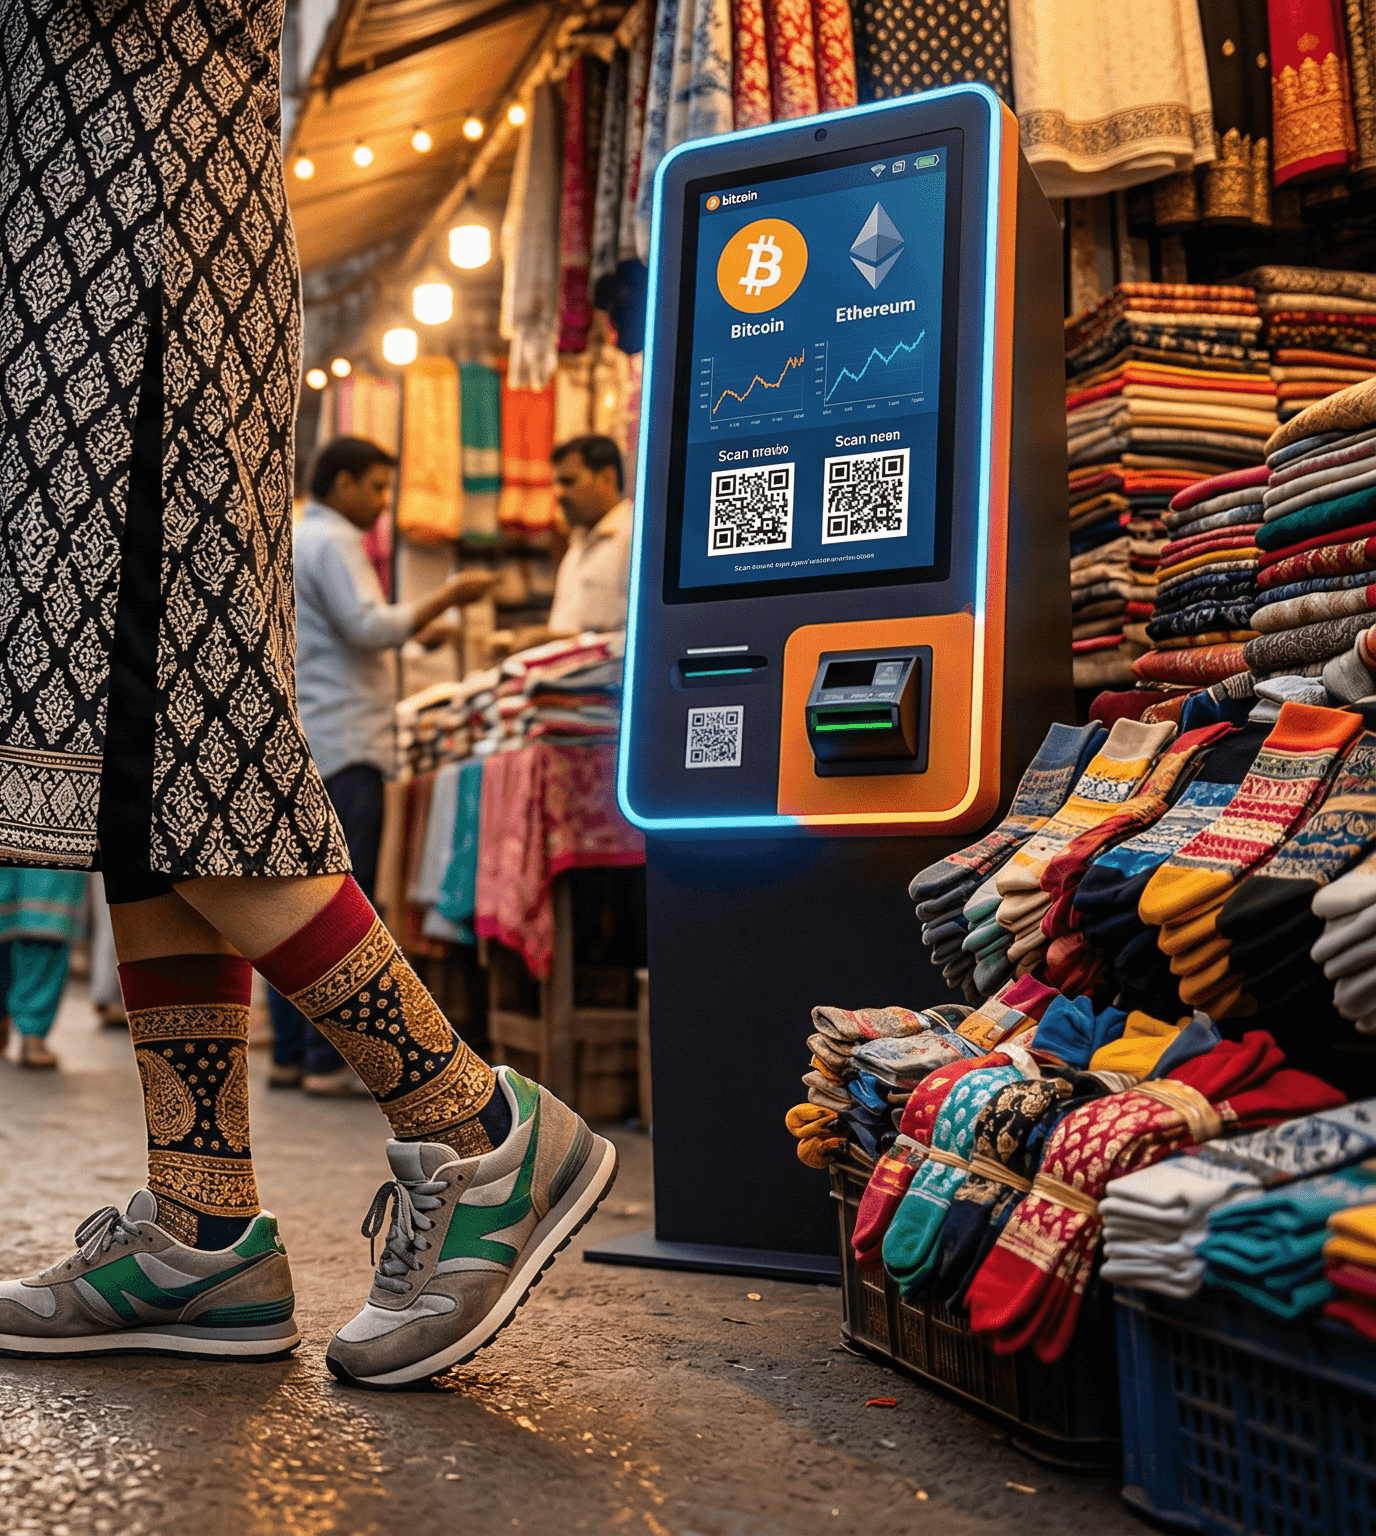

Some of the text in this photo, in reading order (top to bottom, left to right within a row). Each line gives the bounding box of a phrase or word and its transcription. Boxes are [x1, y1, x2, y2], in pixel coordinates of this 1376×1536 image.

[836, 297, 916, 323] Ethereum
[731, 317, 784, 339] Bitcoin
[835, 435, 866, 448] Scan
[718, 450, 749, 462] Scan
